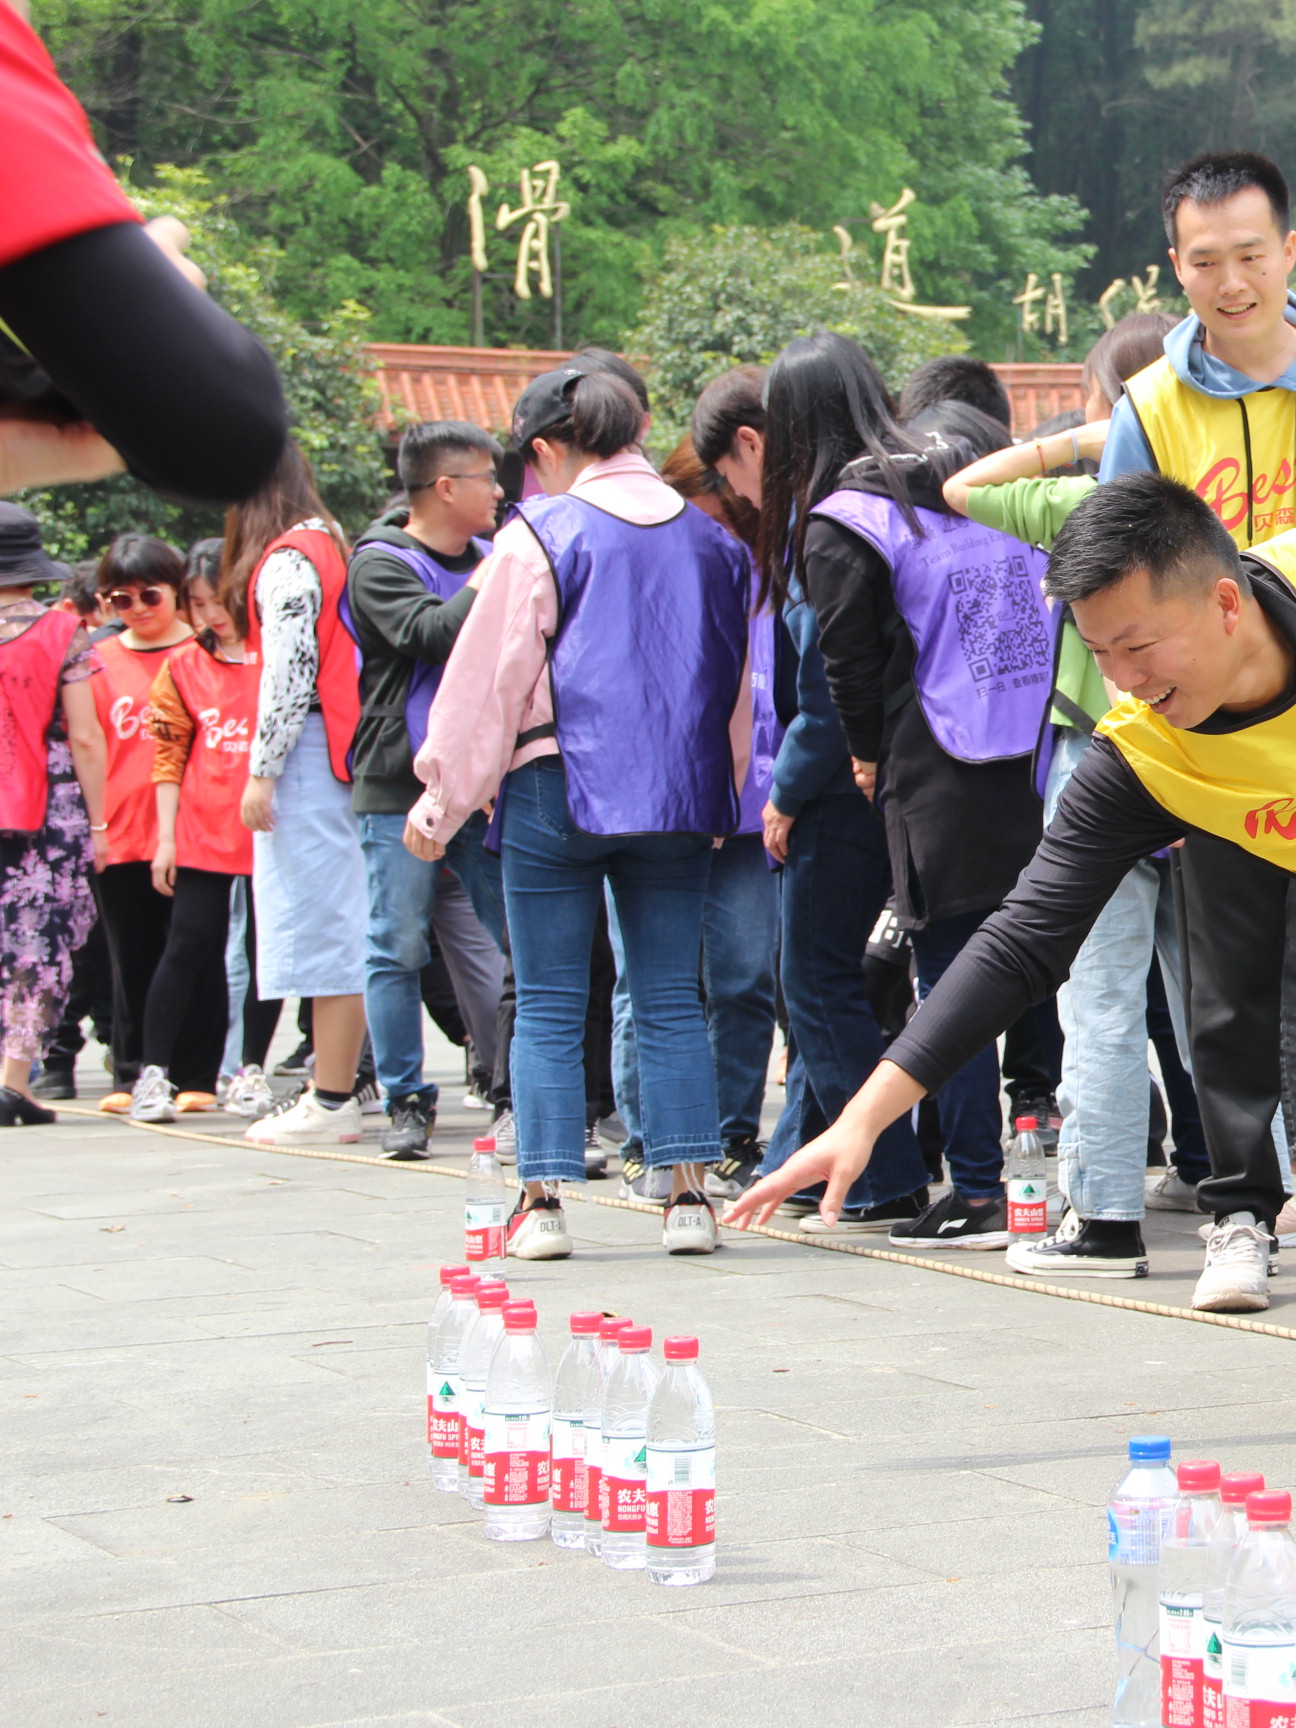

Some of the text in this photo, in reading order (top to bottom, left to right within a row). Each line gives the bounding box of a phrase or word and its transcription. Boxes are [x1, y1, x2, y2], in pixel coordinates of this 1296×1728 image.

[920, 550, 952, 568] Team
[949, 535, 991, 554] Building
[677, 1215, 703, 1227] DLT-A
